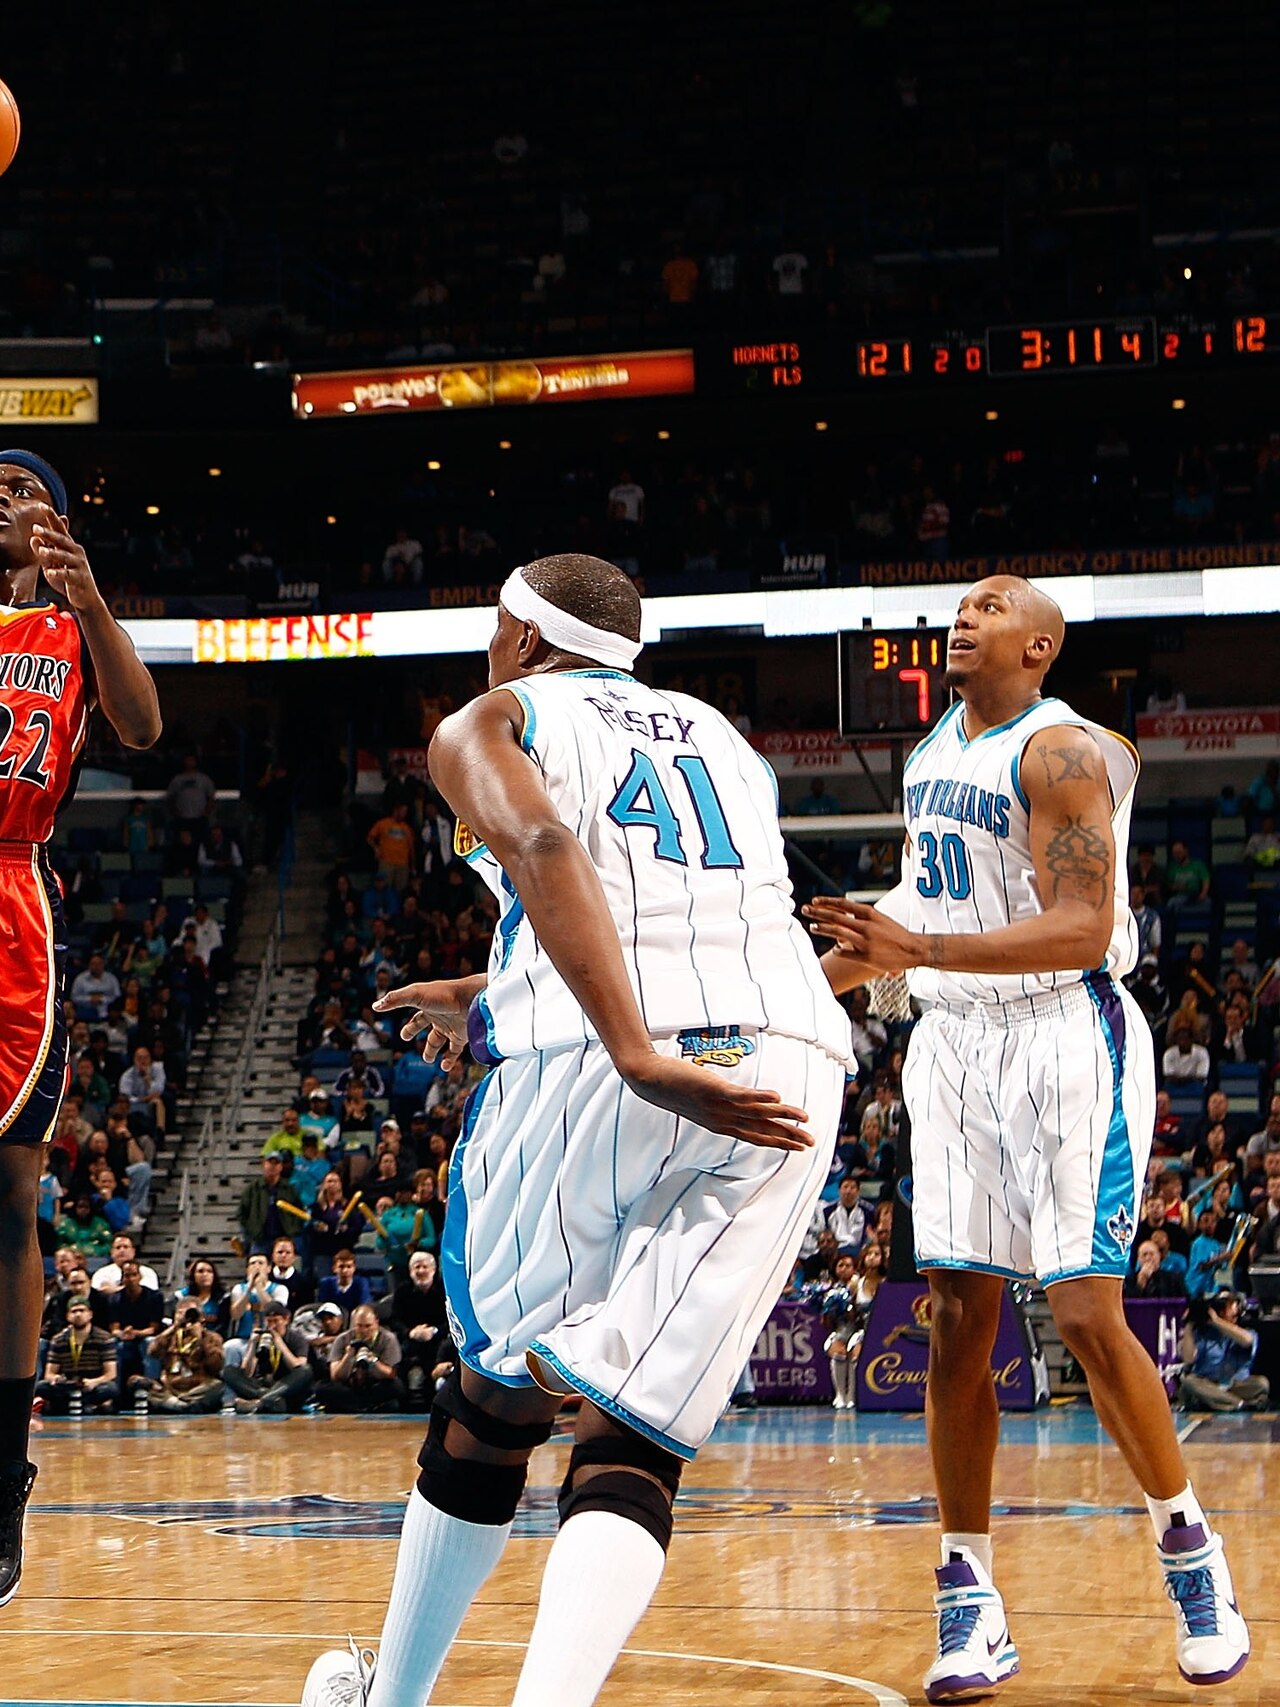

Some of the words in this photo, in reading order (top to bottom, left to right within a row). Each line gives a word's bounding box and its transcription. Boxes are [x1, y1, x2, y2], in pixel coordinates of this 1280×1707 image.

[733, 342, 800, 366] HORNETS
[1020, 325, 1104, 371] 3:11
[1120, 331, 1143, 363] 4
[1163, 332, 1182, 360] 2
[1204, 330, 1215, 356] 1
[859, 342, 912, 377] 121
[932, 349, 950, 375] 2
[964, 345, 983, 374] 0
[773, 366, 802, 387] FLS
[860, 558, 988, 584] INSURANCE
[995, 553, 1087, 578] AGENCY
[1092, 550, 1121, 573] OF
[1126, 545, 1172, 571] THE
[872, 637, 938, 670] 3:11
[898, 668, 929, 723] 7
[1184, 713, 1265, 735] TOYOTA
[606, 747, 746, 870] 41
[926, 779, 1012, 839] ORLEANS
[916, 831, 972, 901] 30
